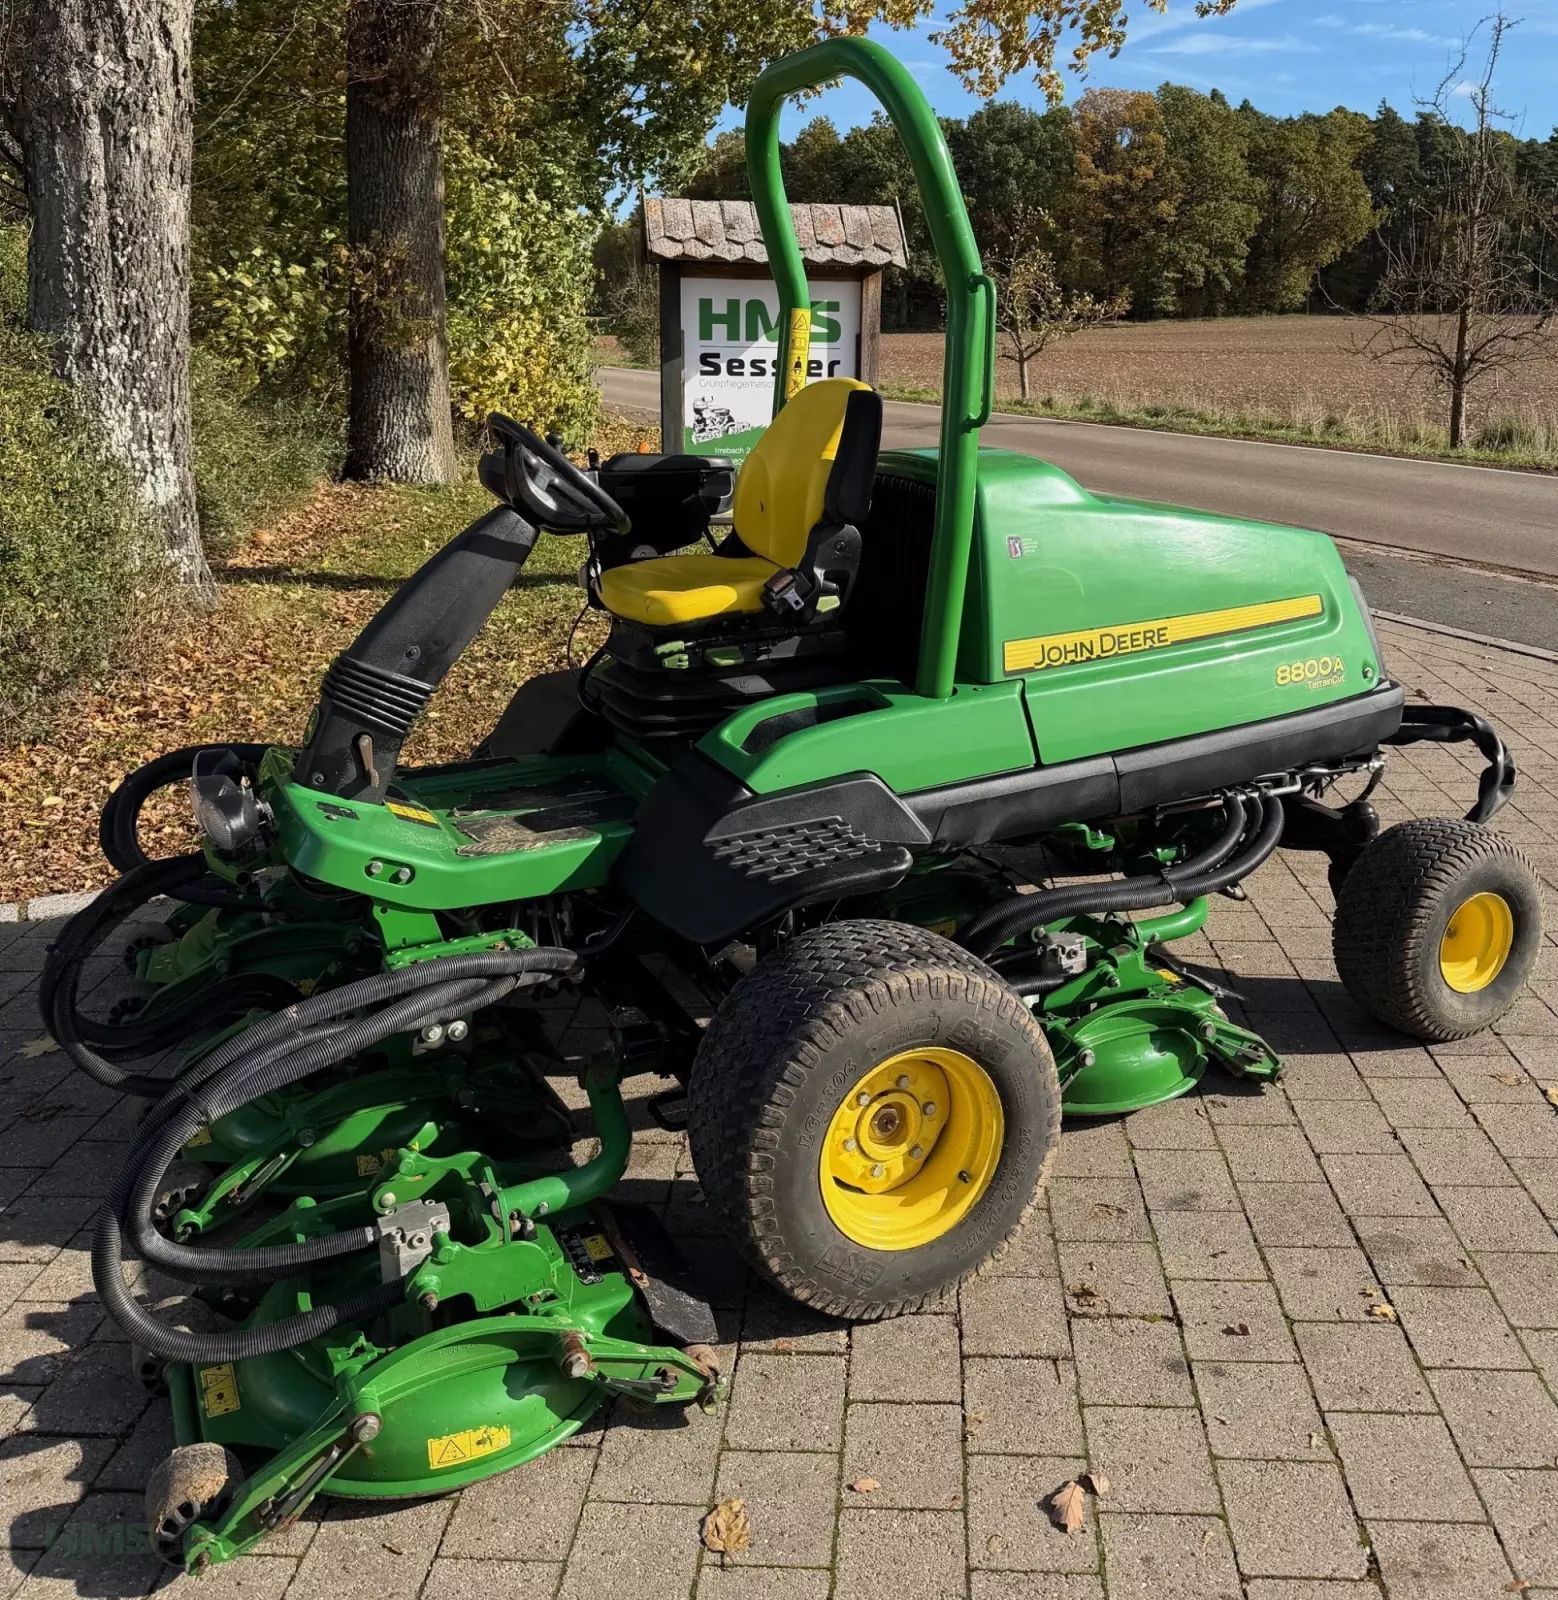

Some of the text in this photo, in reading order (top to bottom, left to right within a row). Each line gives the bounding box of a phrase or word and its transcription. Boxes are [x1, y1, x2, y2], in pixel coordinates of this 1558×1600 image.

[698, 297, 841, 343] HMS
[699, 352, 841, 377] Seser
[1033, 626, 1169, 666] JOHN DEERE
[1276, 656, 1345, 685] 8800A
[1307, 674, 1345, 690] TerrainCut
[815, 1244, 889, 1290] BKT
